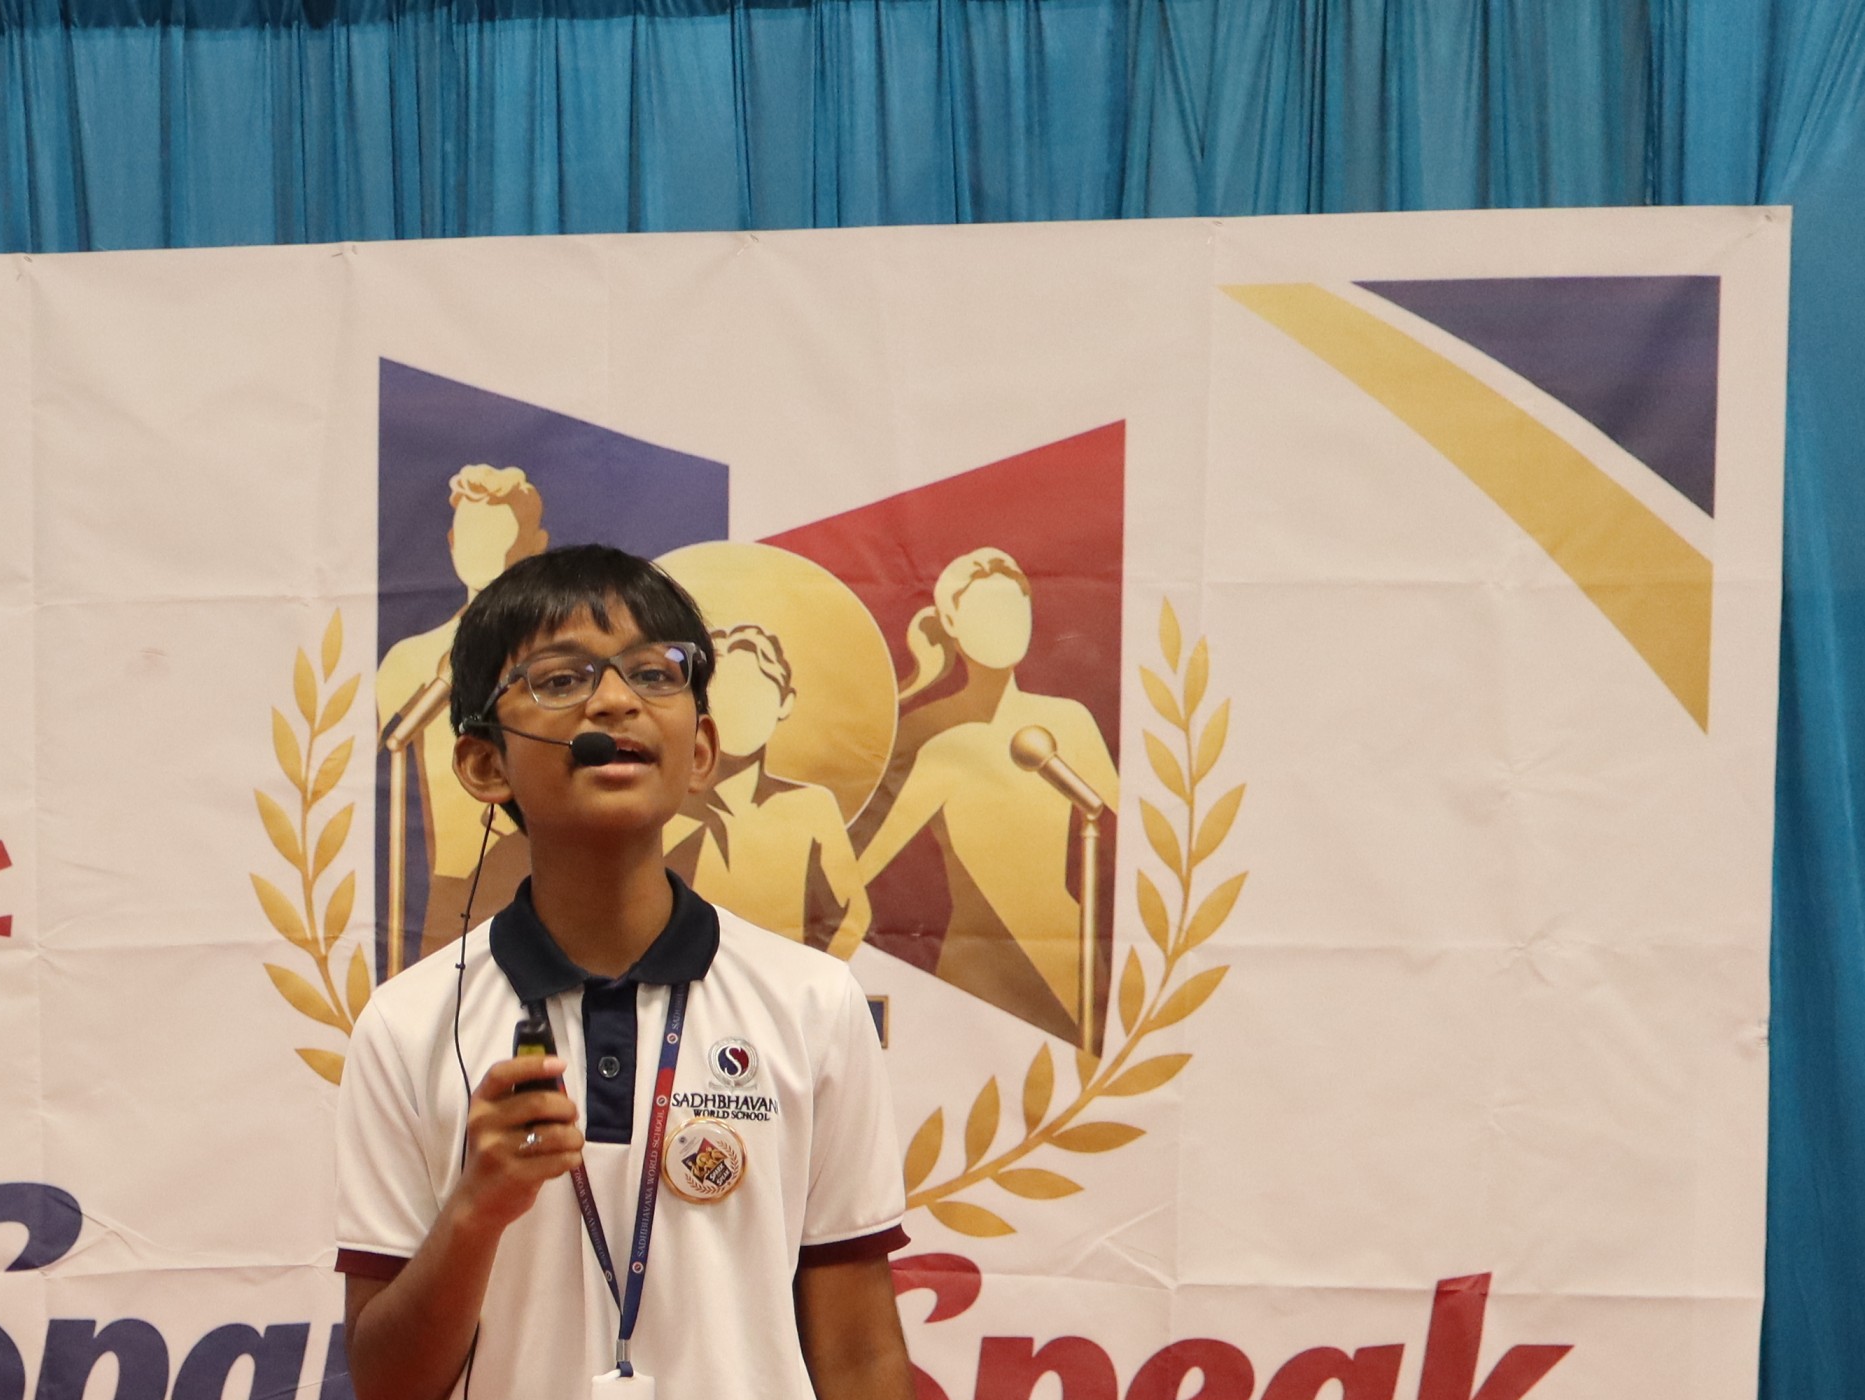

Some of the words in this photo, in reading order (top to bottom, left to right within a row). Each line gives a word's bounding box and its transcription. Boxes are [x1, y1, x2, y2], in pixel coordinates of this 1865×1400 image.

[693, 1108, 730, 1119] WORLD
[731, 1109, 771, 1122] SCHOOL
[646, 1151, 658, 1185] WORLD
[652, 1110, 665, 1150] SCHOOL
